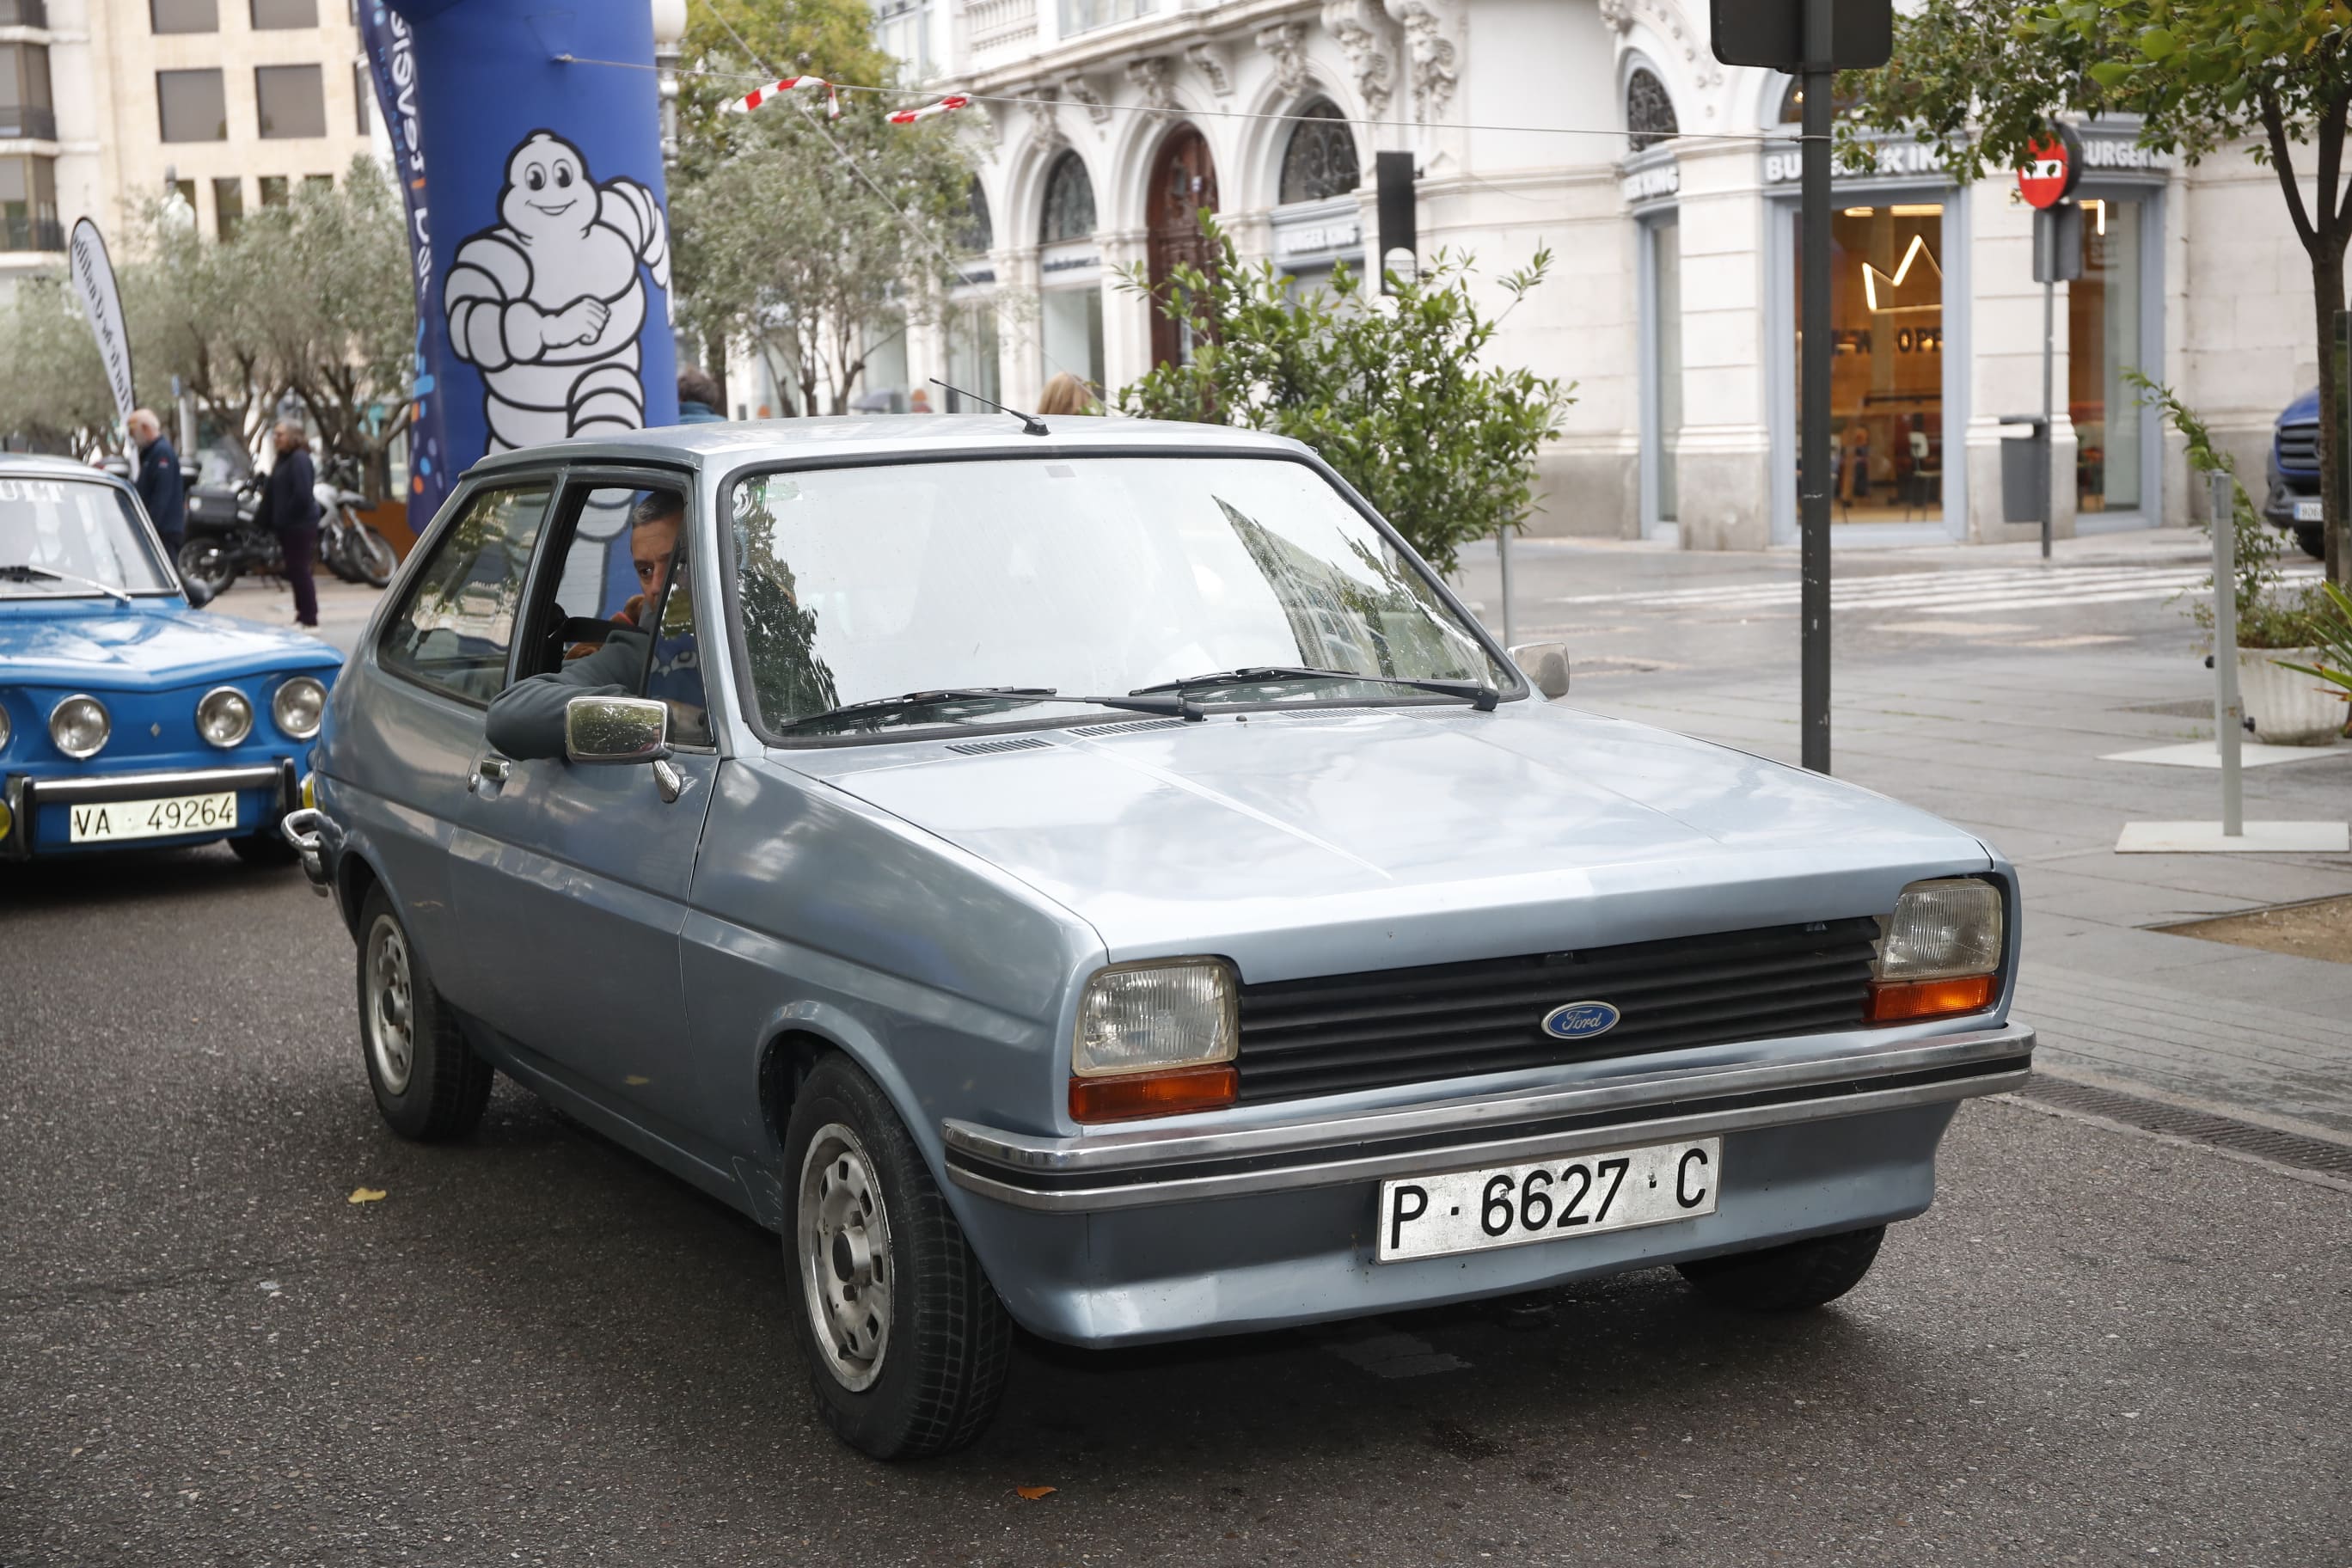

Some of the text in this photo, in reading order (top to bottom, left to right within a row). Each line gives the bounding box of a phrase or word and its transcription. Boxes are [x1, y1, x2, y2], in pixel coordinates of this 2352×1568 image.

[75, 796, 233, 836] VA 49264
[1561, 1009, 1603, 1031] Ford
[1480, 1157, 1630, 1237] 6627
